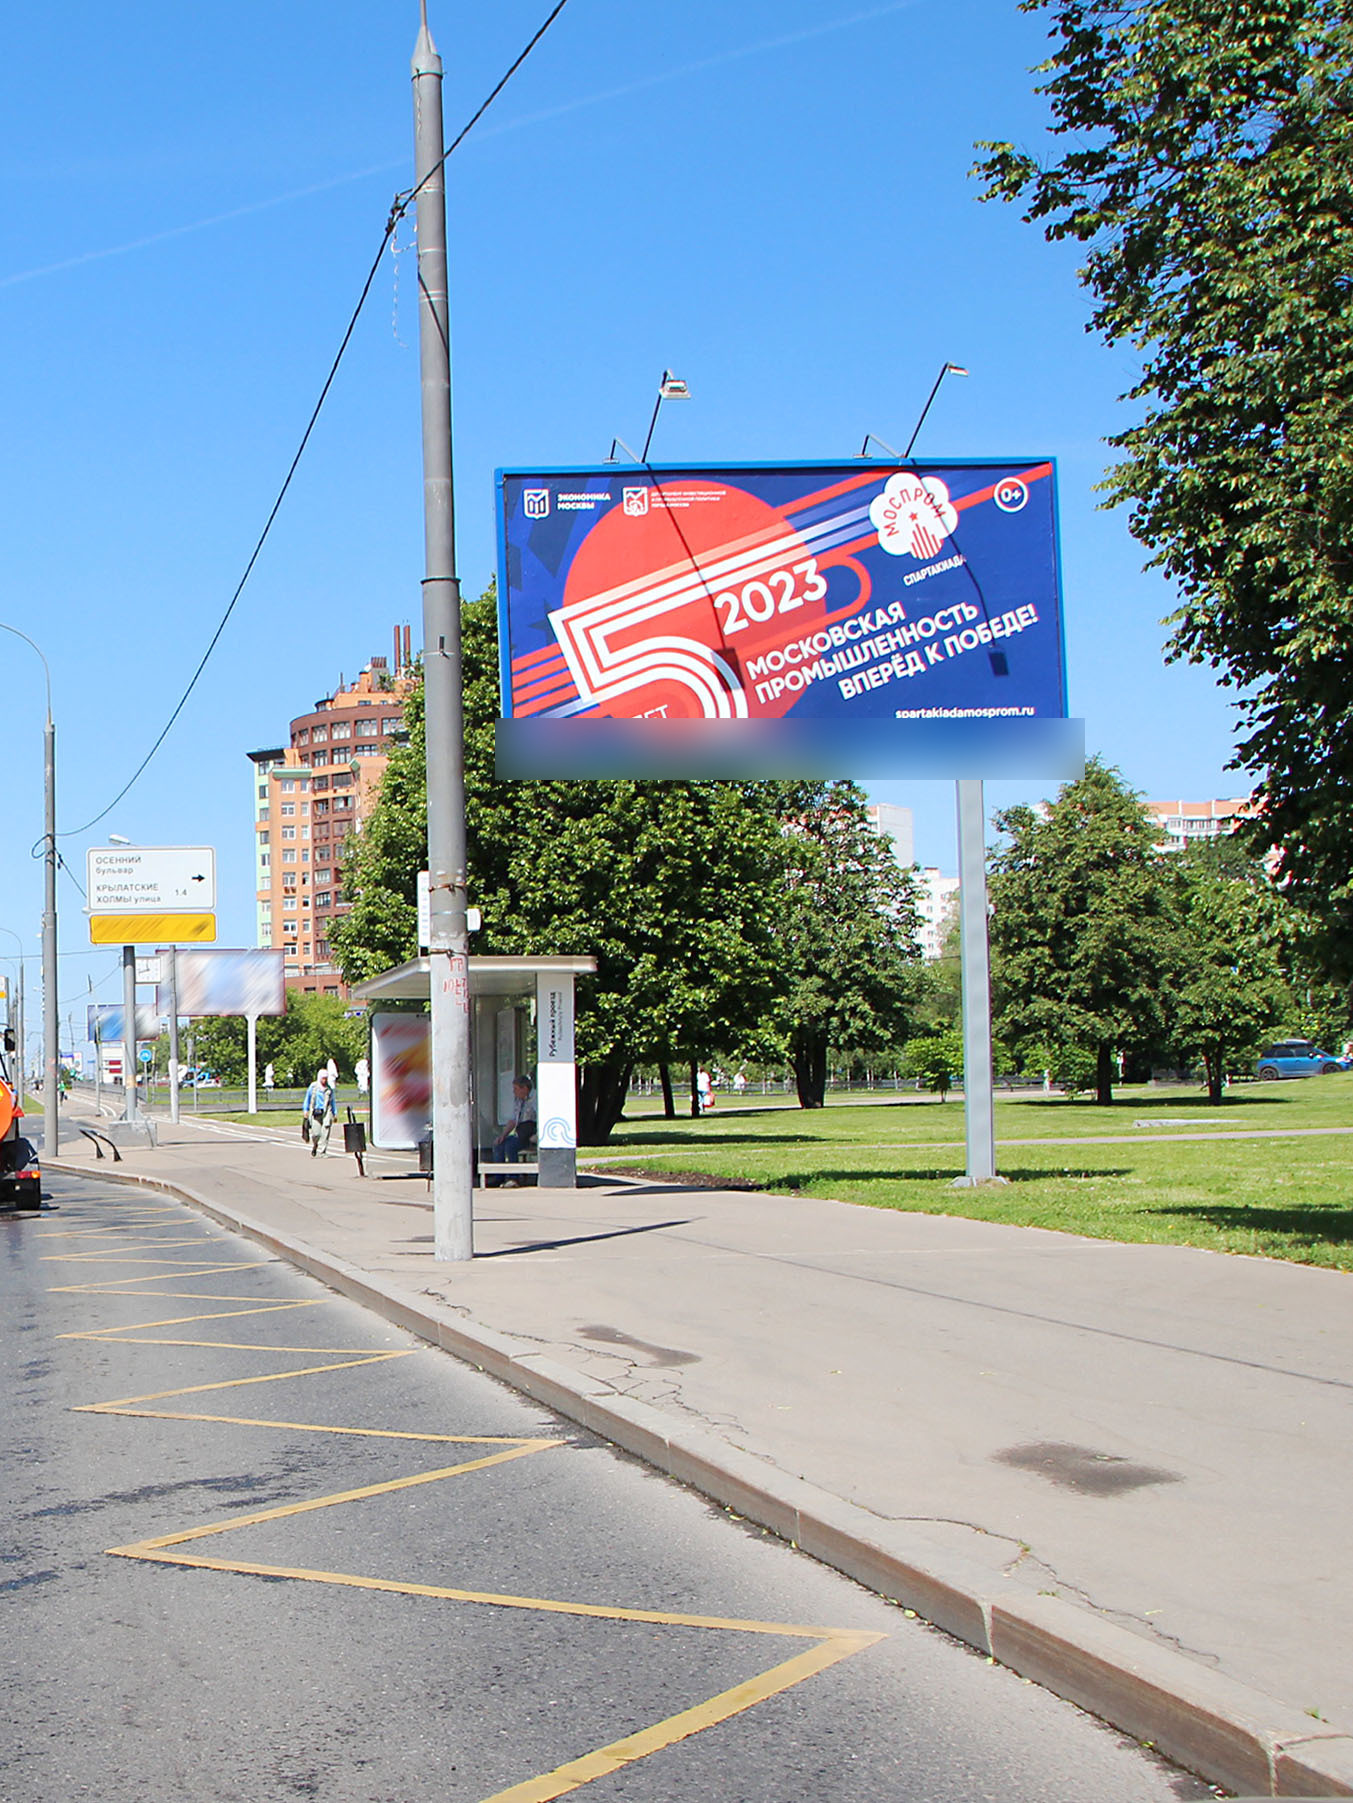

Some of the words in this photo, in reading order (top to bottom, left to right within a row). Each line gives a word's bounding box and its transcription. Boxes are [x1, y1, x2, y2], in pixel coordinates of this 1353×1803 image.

[557, 493, 611, 502] ЭКОНОМИКА
[1000, 487, 1022, 503] 0+
[557, 502, 595, 510] МОСКВЫ
[883, 487, 947, 537] МОСПРОМ
[714, 558, 828, 635] 2023
[746, 601, 906, 680] МОСКОВСКАЯ
[755, 602, 979, 704] ПРОМЫШЛЕННОСТЬ
[838, 651, 927, 700] ВПЕРЁД
[924, 642, 945, 665] К
[944, 603, 1039, 658] ПОБЕДЕ!
[96, 856, 142, 865] ОСЕННИЙ
[96, 867, 134, 876] бульвар
[96, 883, 159, 892] КРЫЛАТСКИЕ
[97, 896, 132, 904] ХОЛМЫ
[134, 896, 161, 904] улица
